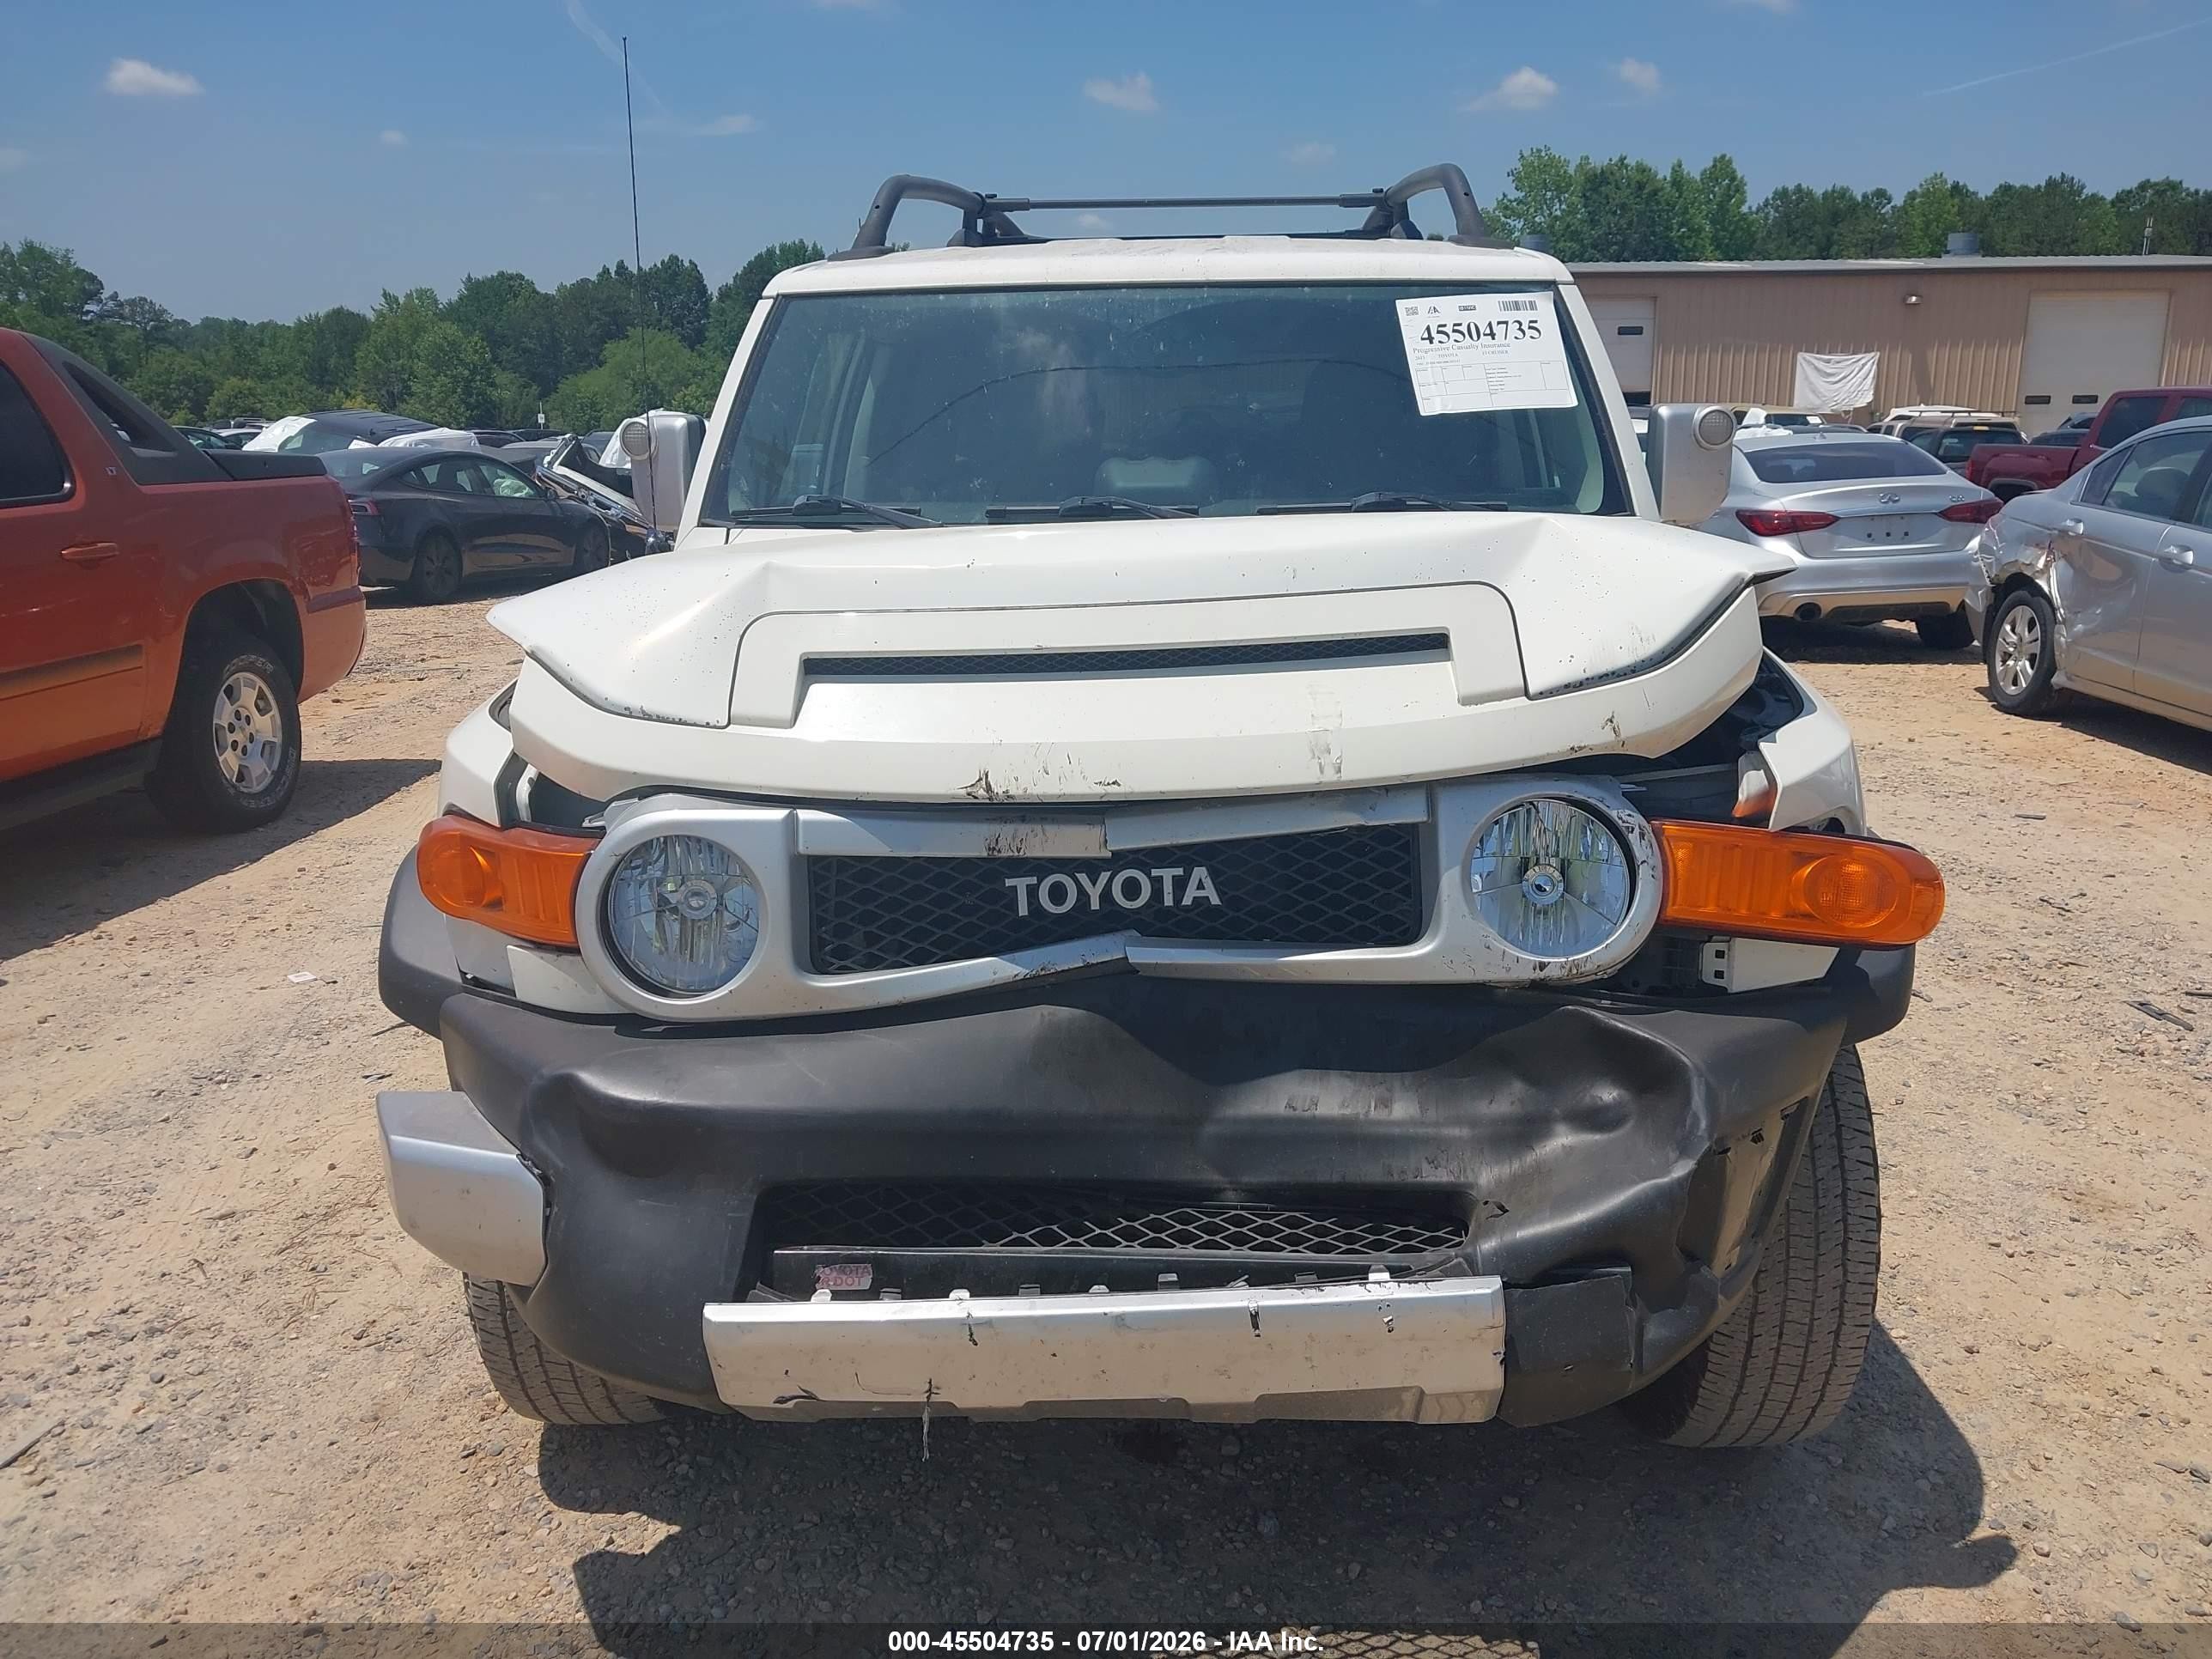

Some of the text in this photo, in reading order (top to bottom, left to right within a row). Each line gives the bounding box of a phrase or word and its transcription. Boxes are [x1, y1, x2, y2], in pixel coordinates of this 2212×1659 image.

[1420, 319, 1542, 345] 45504735
[1413, 345, 1450, 355] Progressive
[1005, 866, 1223, 917] TOYOTA
